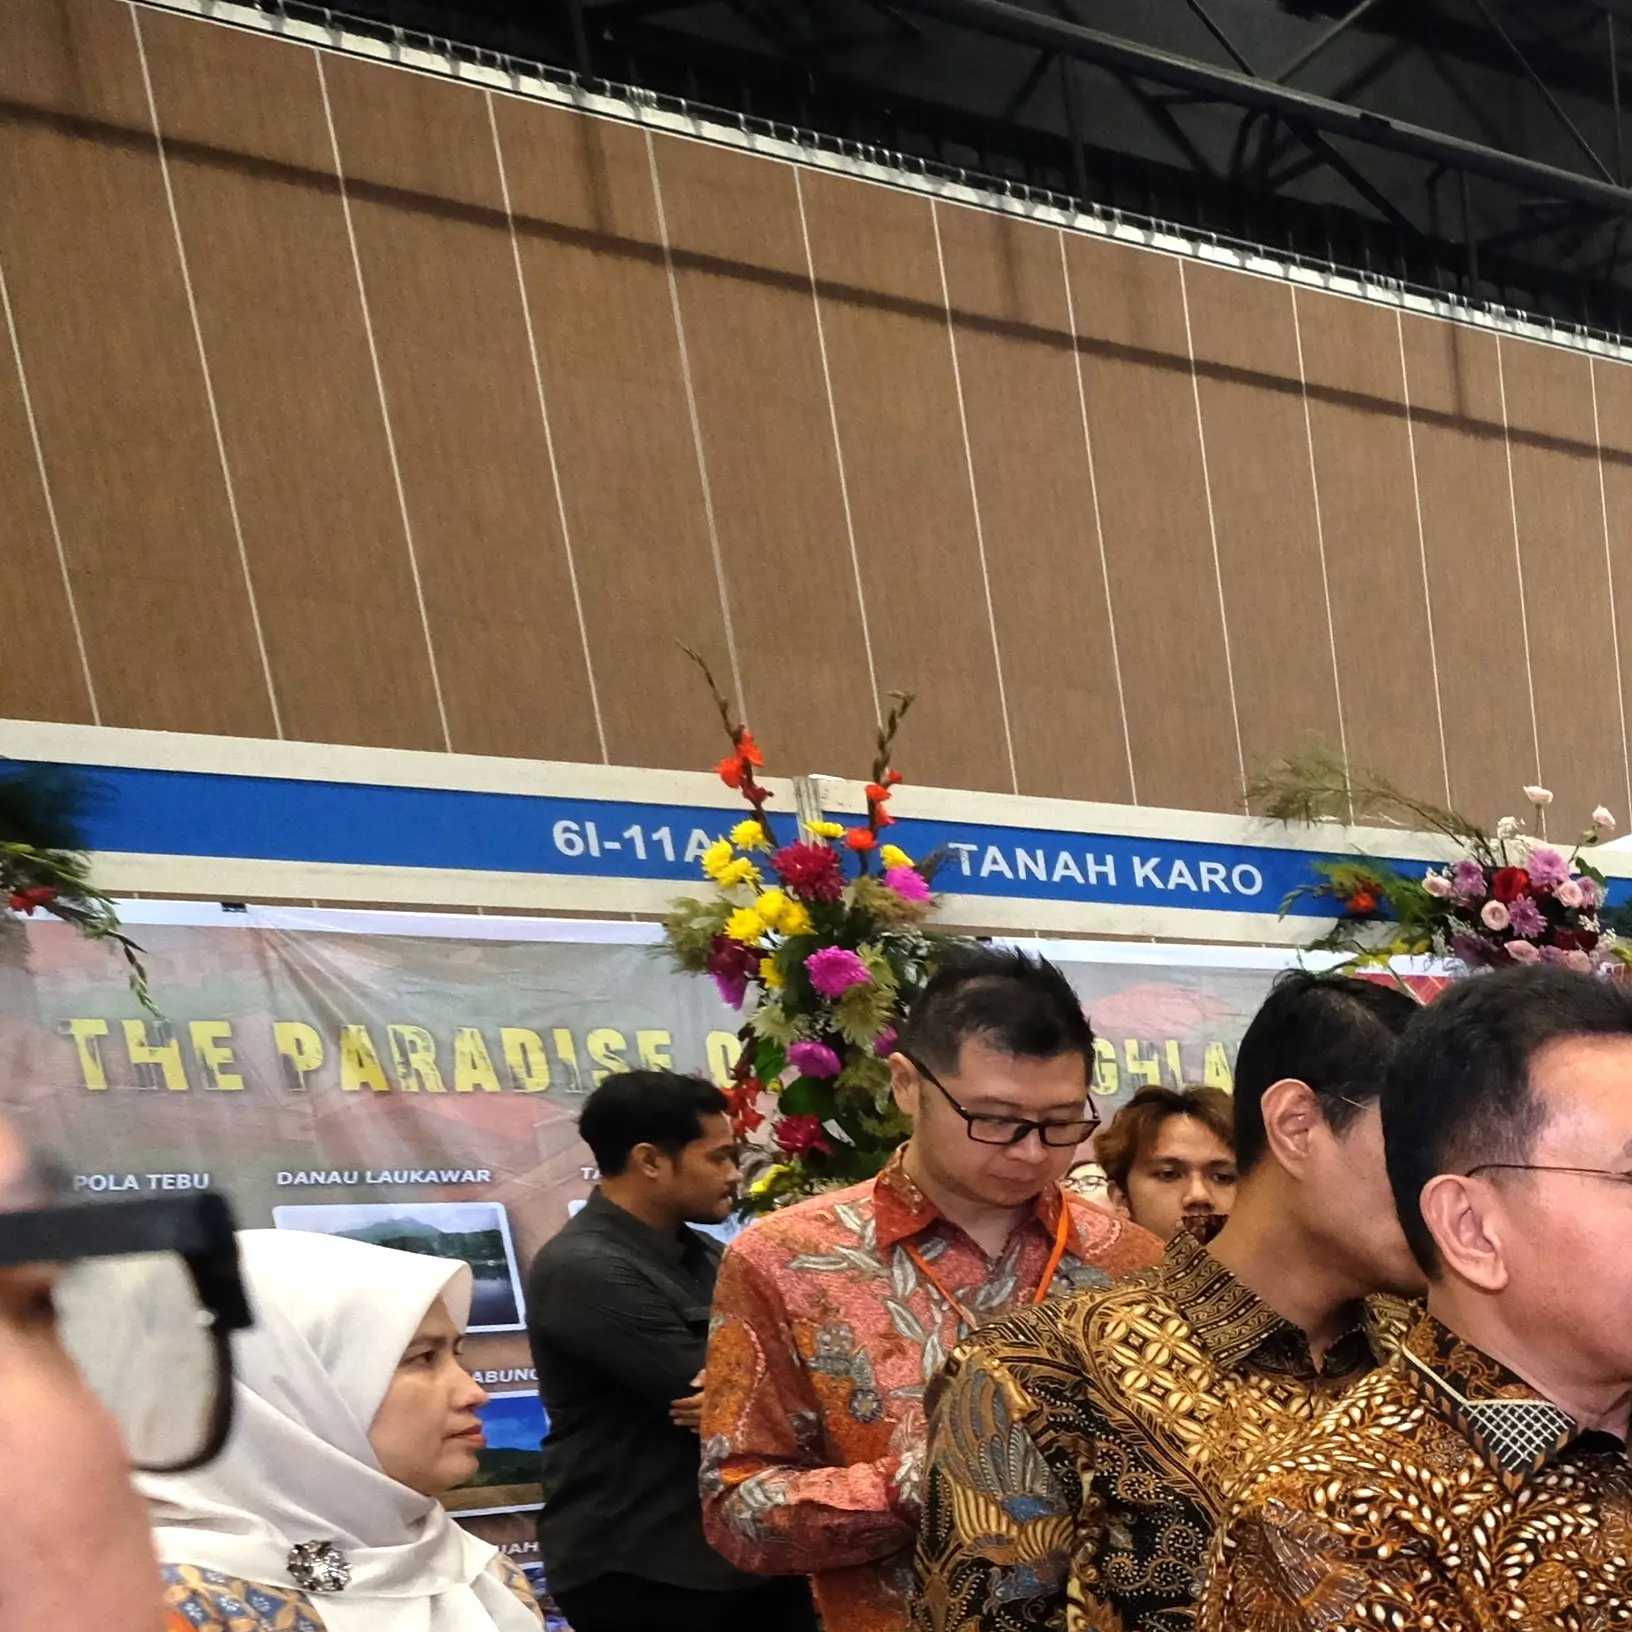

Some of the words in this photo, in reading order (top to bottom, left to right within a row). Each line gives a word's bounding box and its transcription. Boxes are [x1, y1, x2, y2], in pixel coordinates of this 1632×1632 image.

[553, 819, 712, 863] 6I-11A
[947, 842, 1118, 887] TANAH
[1132, 856, 1264, 896] KARO
[57, 1018, 245, 1091] THE
[273, 1021, 673, 1094] PARADISE
[74, 1174, 140, 1192] POLA
[147, 1173, 209, 1191] TEBU
[276, 1170, 360, 1186] DANAU
[365, 1168, 491, 1185] LAUKAWAR
